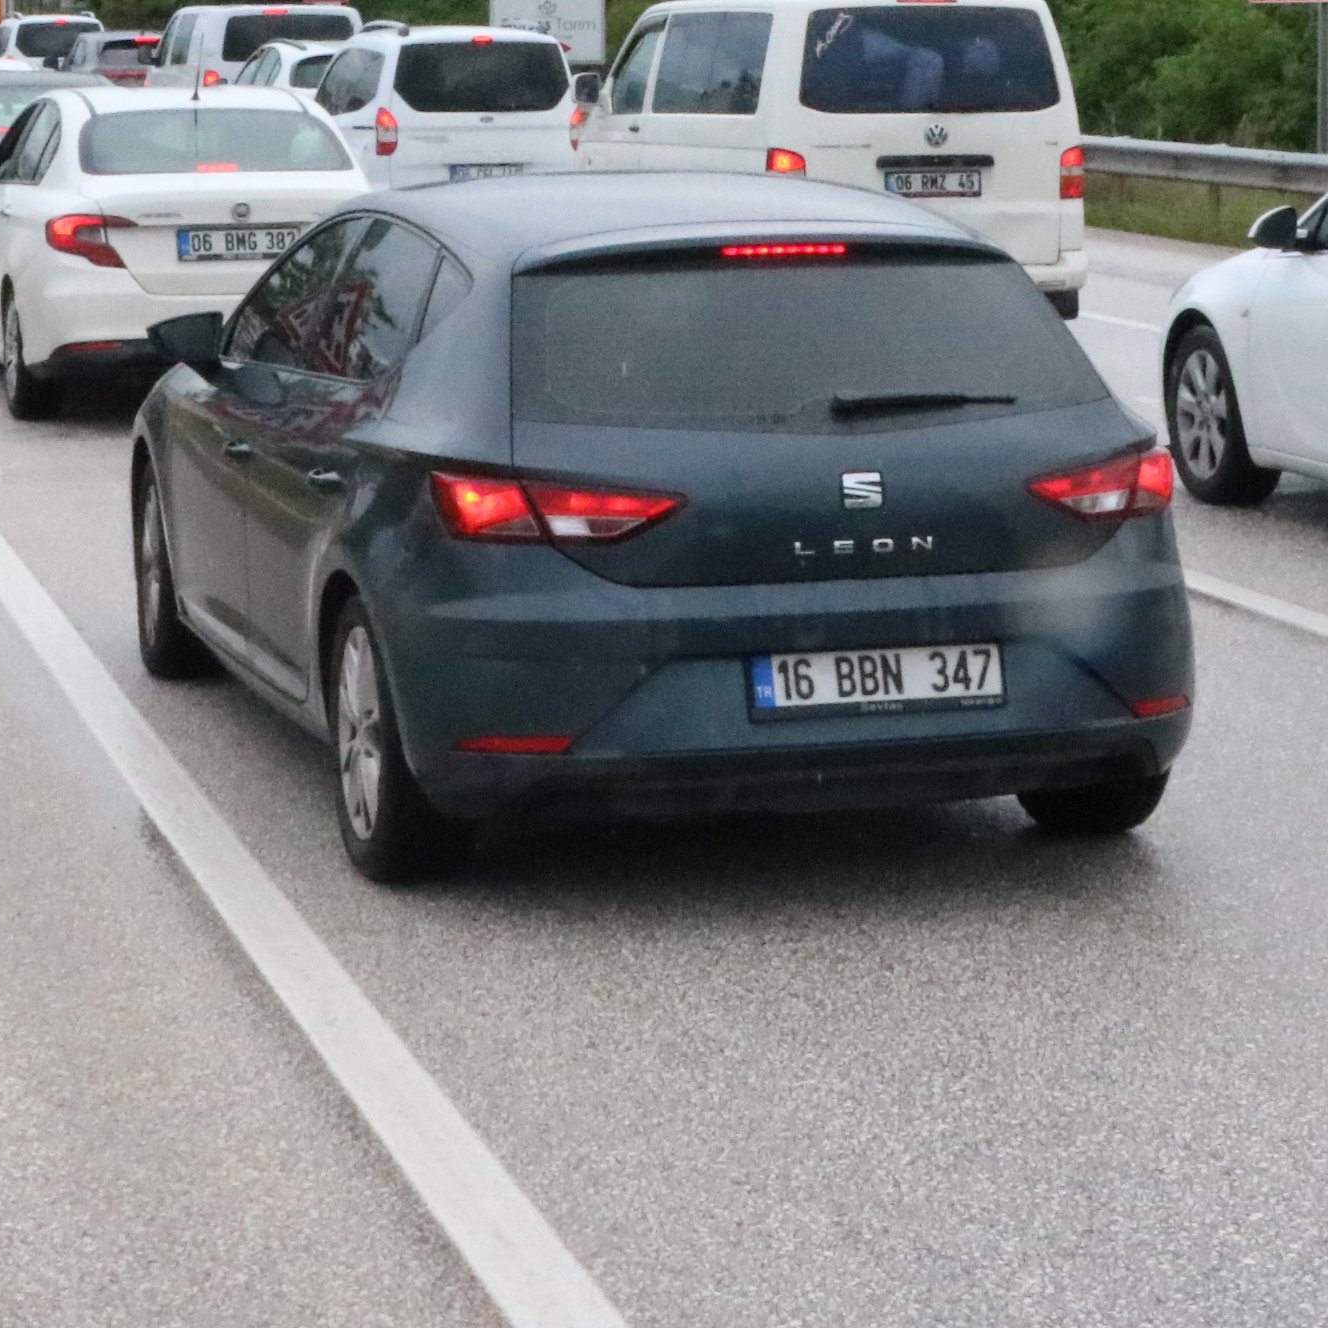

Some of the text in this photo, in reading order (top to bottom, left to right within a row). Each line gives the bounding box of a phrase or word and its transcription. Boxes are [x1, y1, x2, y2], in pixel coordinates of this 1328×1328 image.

[895, 175, 912, 190] 06
[921, 174, 946, 190] RMZ
[191, 233, 212, 252] 06
[224, 232, 258, 251] BMG
[794, 535, 933, 555] LEON
[777, 647, 992, 701] 16 BBN 347
[755, 685, 774, 699] TR
